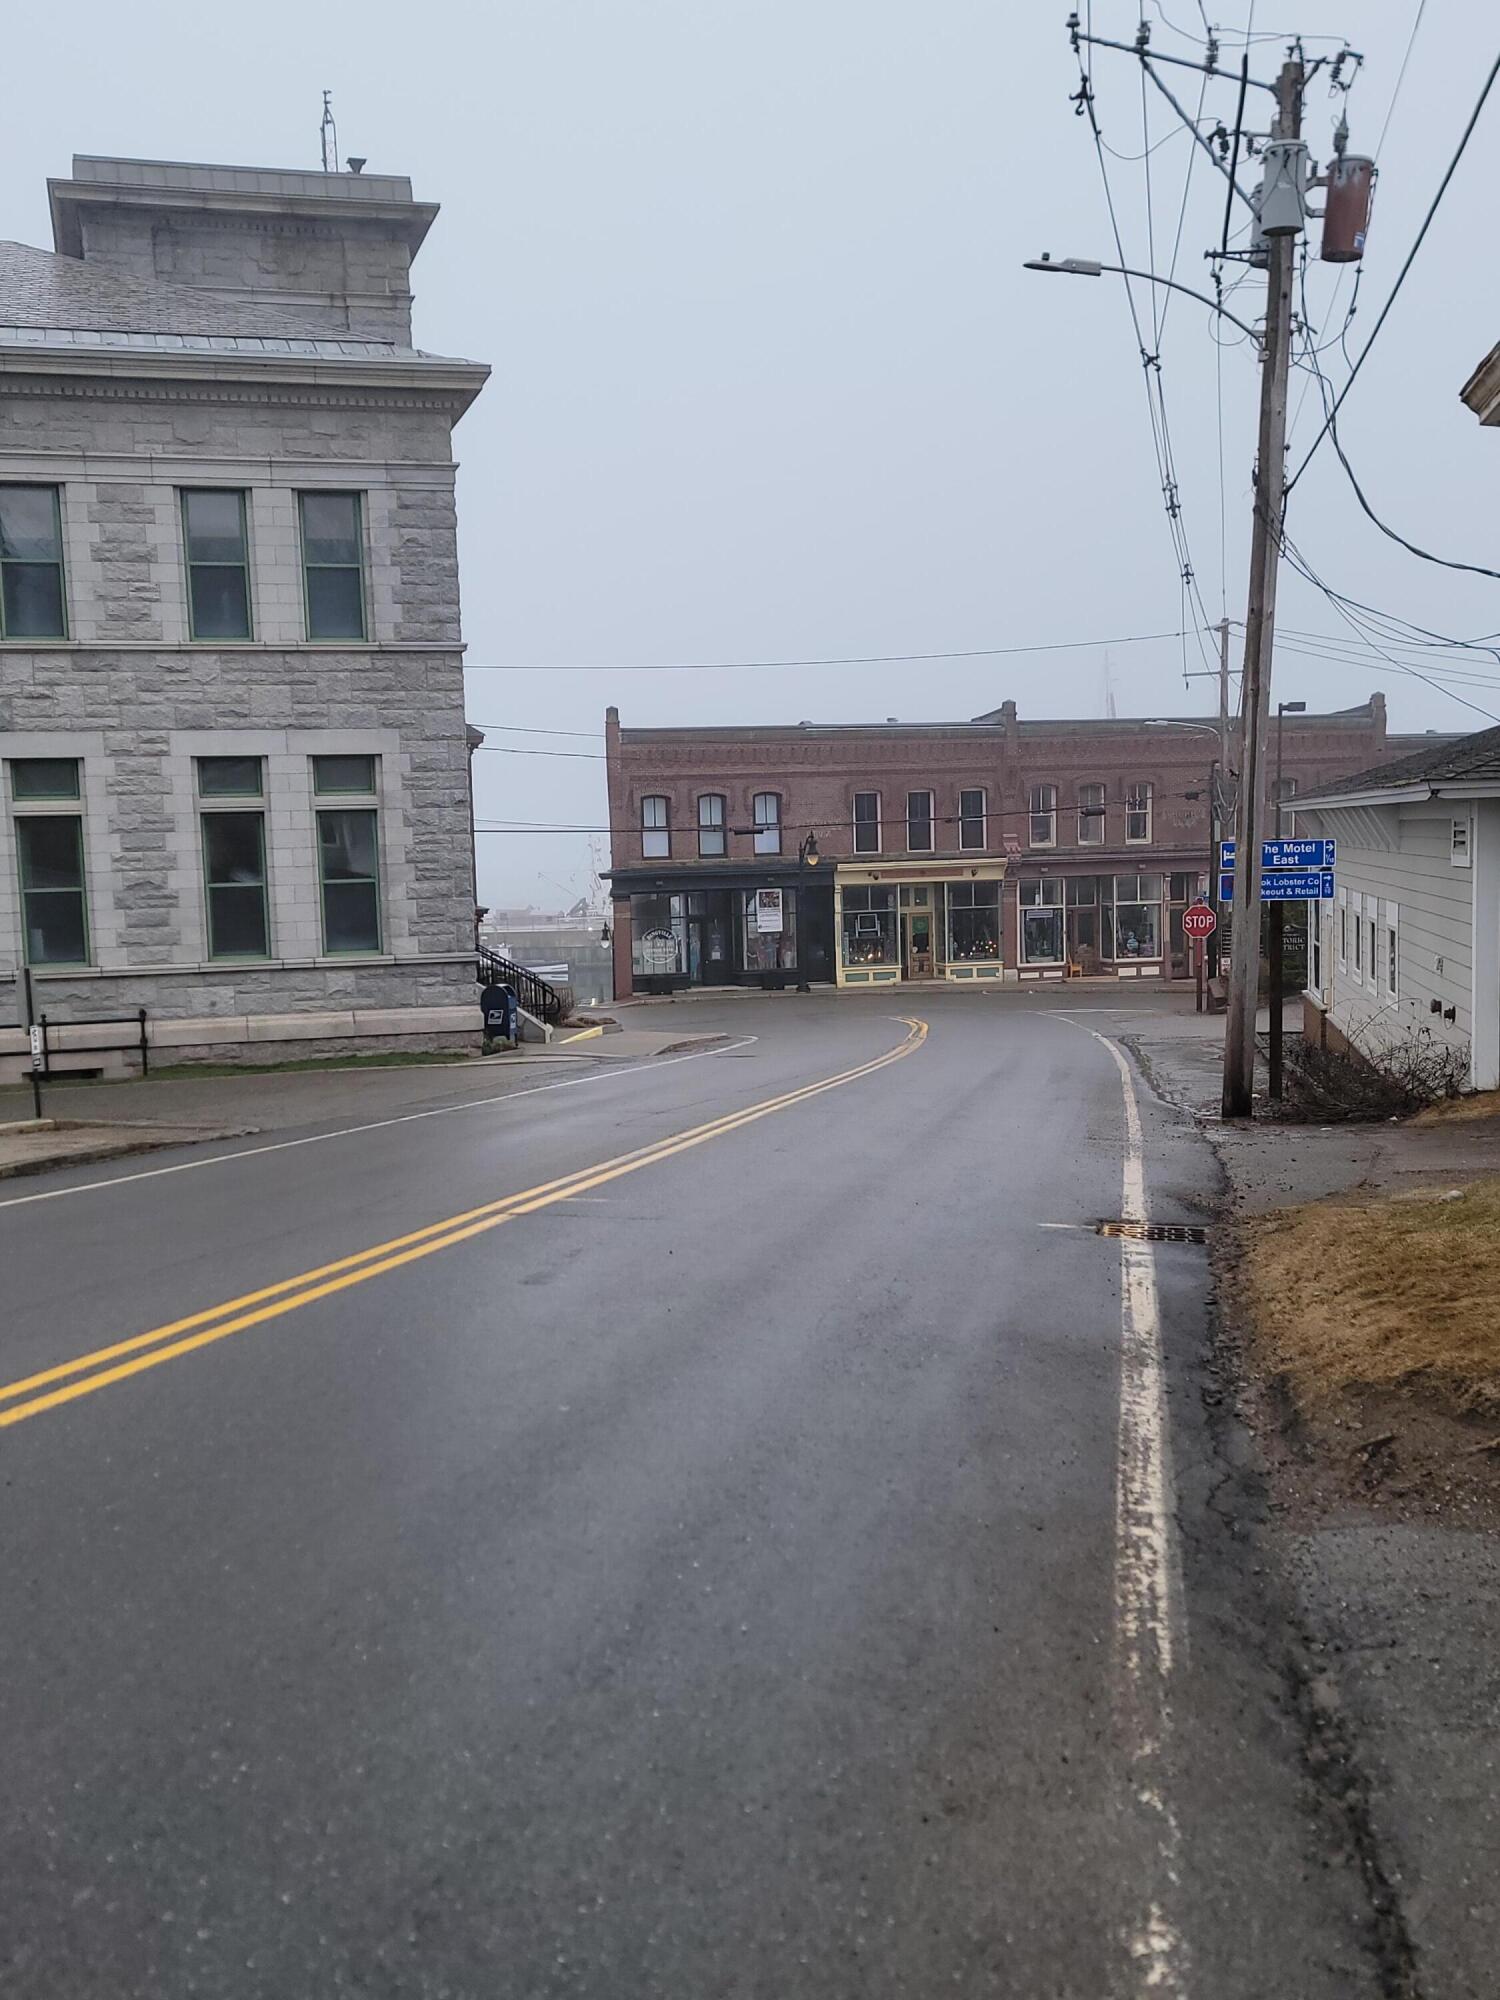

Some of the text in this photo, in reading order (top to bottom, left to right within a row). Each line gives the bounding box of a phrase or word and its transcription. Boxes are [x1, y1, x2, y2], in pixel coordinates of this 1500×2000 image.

[1283, 843, 1316, 853] Motel
[1273, 855, 1299, 865] East
[1273, 878, 1306, 886] Lobster
[1307, 877, 1320, 885] Co
[1261, 888, 1284, 896] keout
[1295, 887, 1319, 895] Retail
[1185, 915, 1214, 928] STOP
